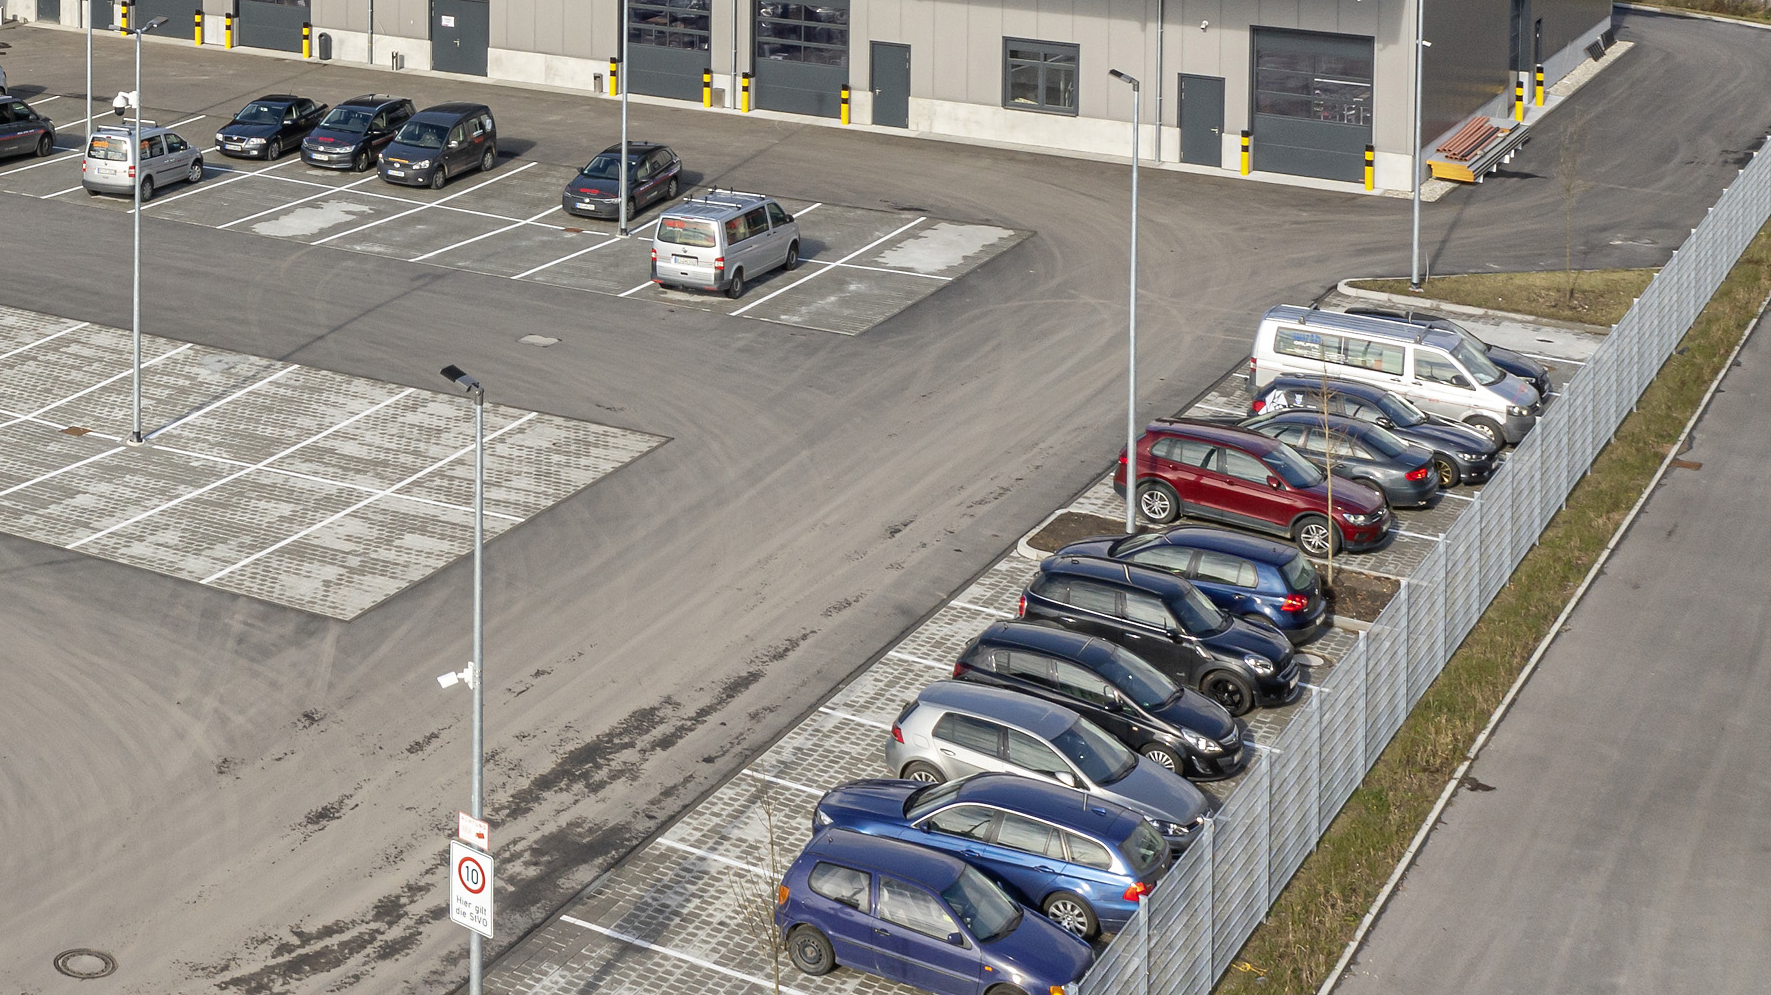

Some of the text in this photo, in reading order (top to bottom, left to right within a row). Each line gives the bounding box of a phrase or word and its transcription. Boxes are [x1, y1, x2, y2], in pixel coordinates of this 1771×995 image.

[465, 865, 479, 885] 10
[456, 894, 487, 916] Hier gilt
[455, 906, 488, 927] die StVO
